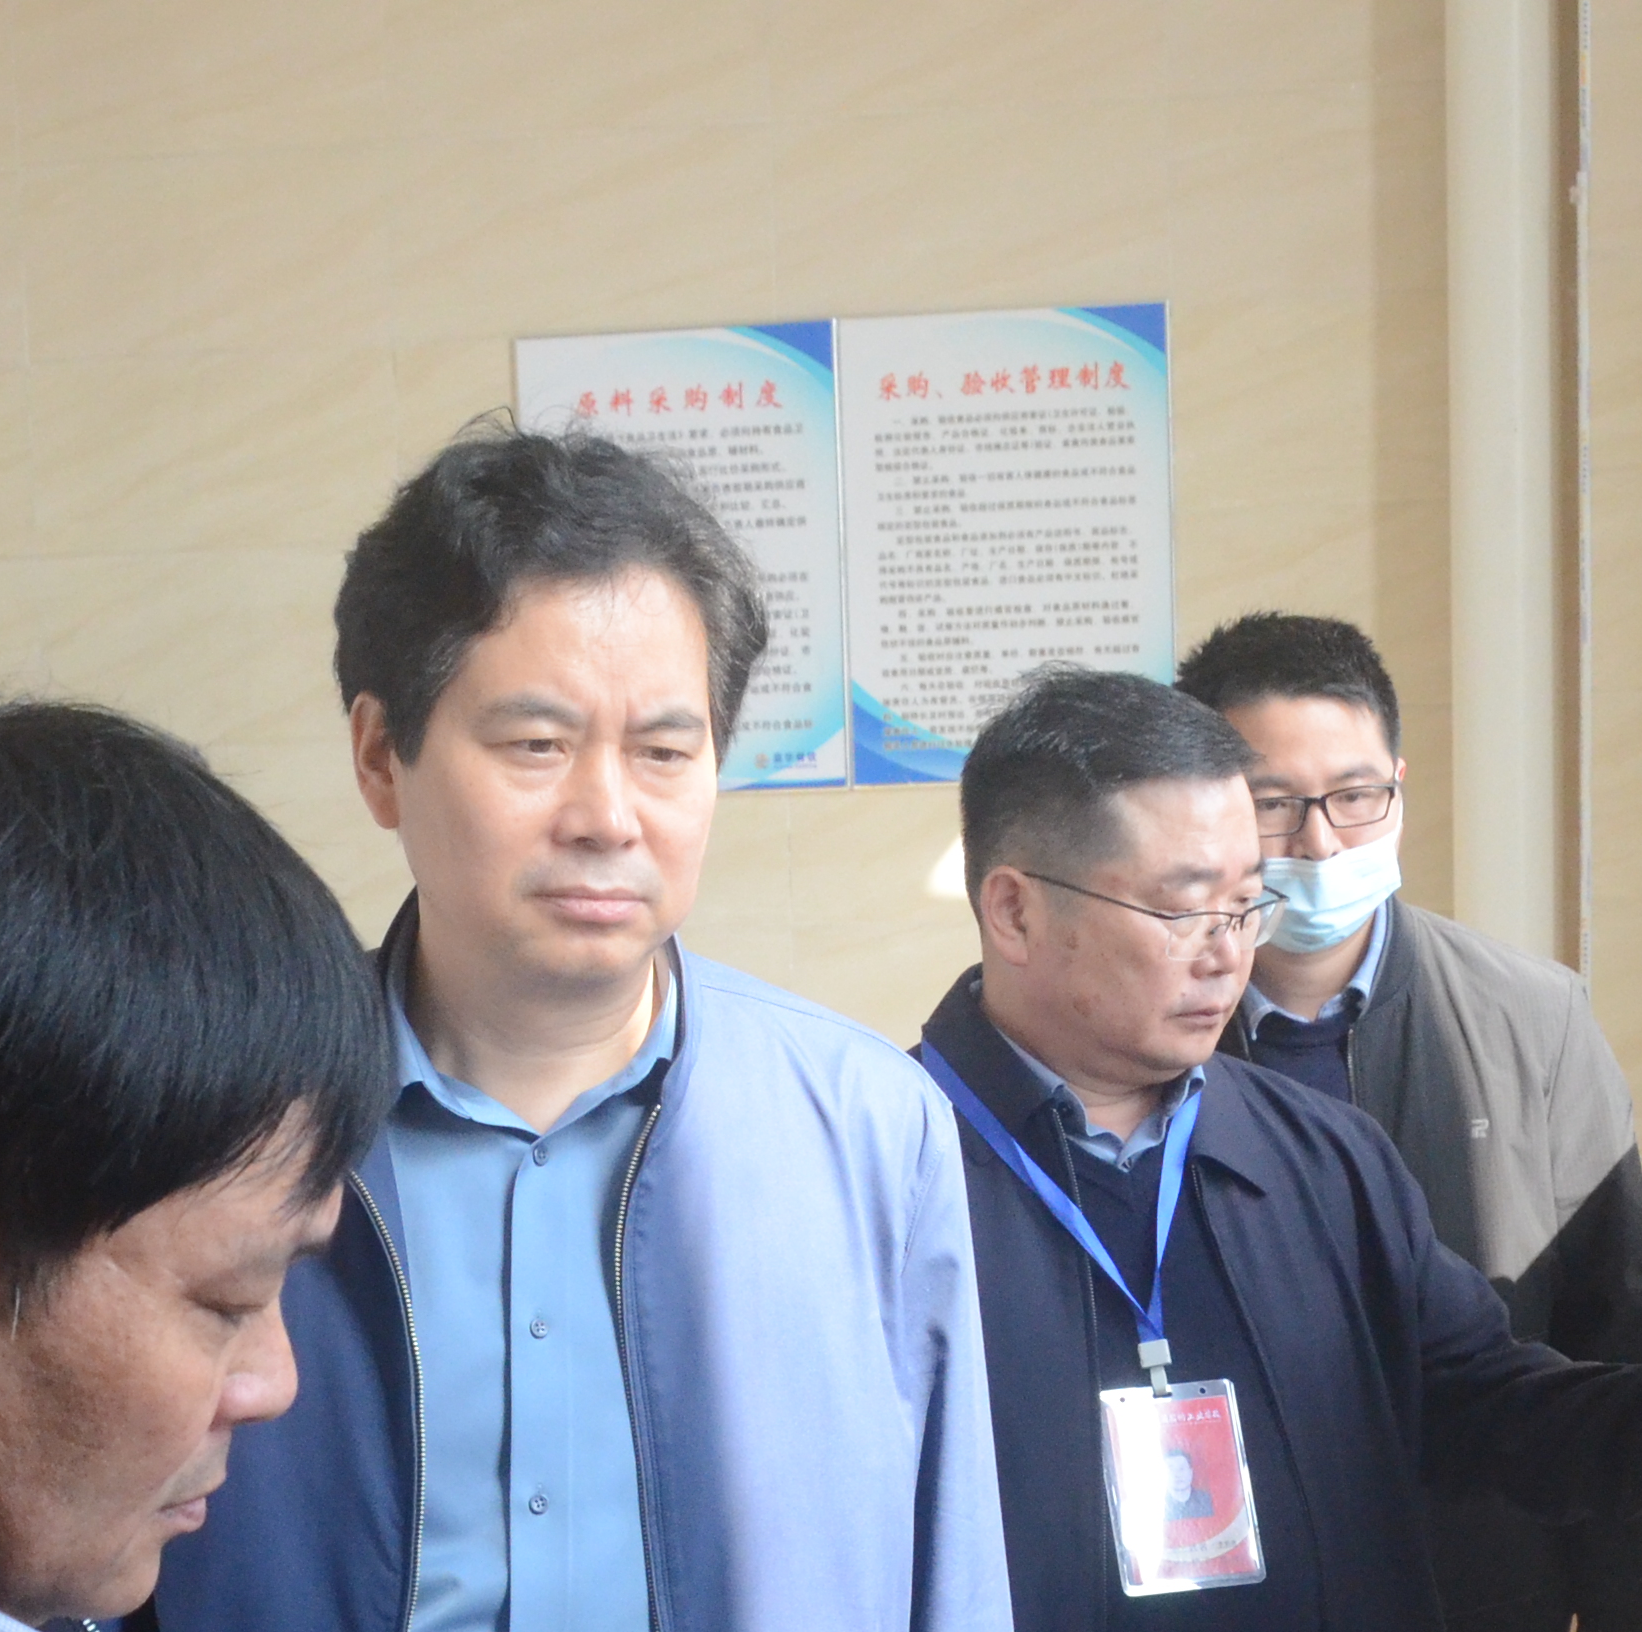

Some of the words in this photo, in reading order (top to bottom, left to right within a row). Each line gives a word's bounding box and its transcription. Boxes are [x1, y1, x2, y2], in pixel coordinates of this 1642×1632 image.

[576, 379, 784, 418] 原料采购制度
[878, 361, 1131, 401] 采购、验收管理制度
